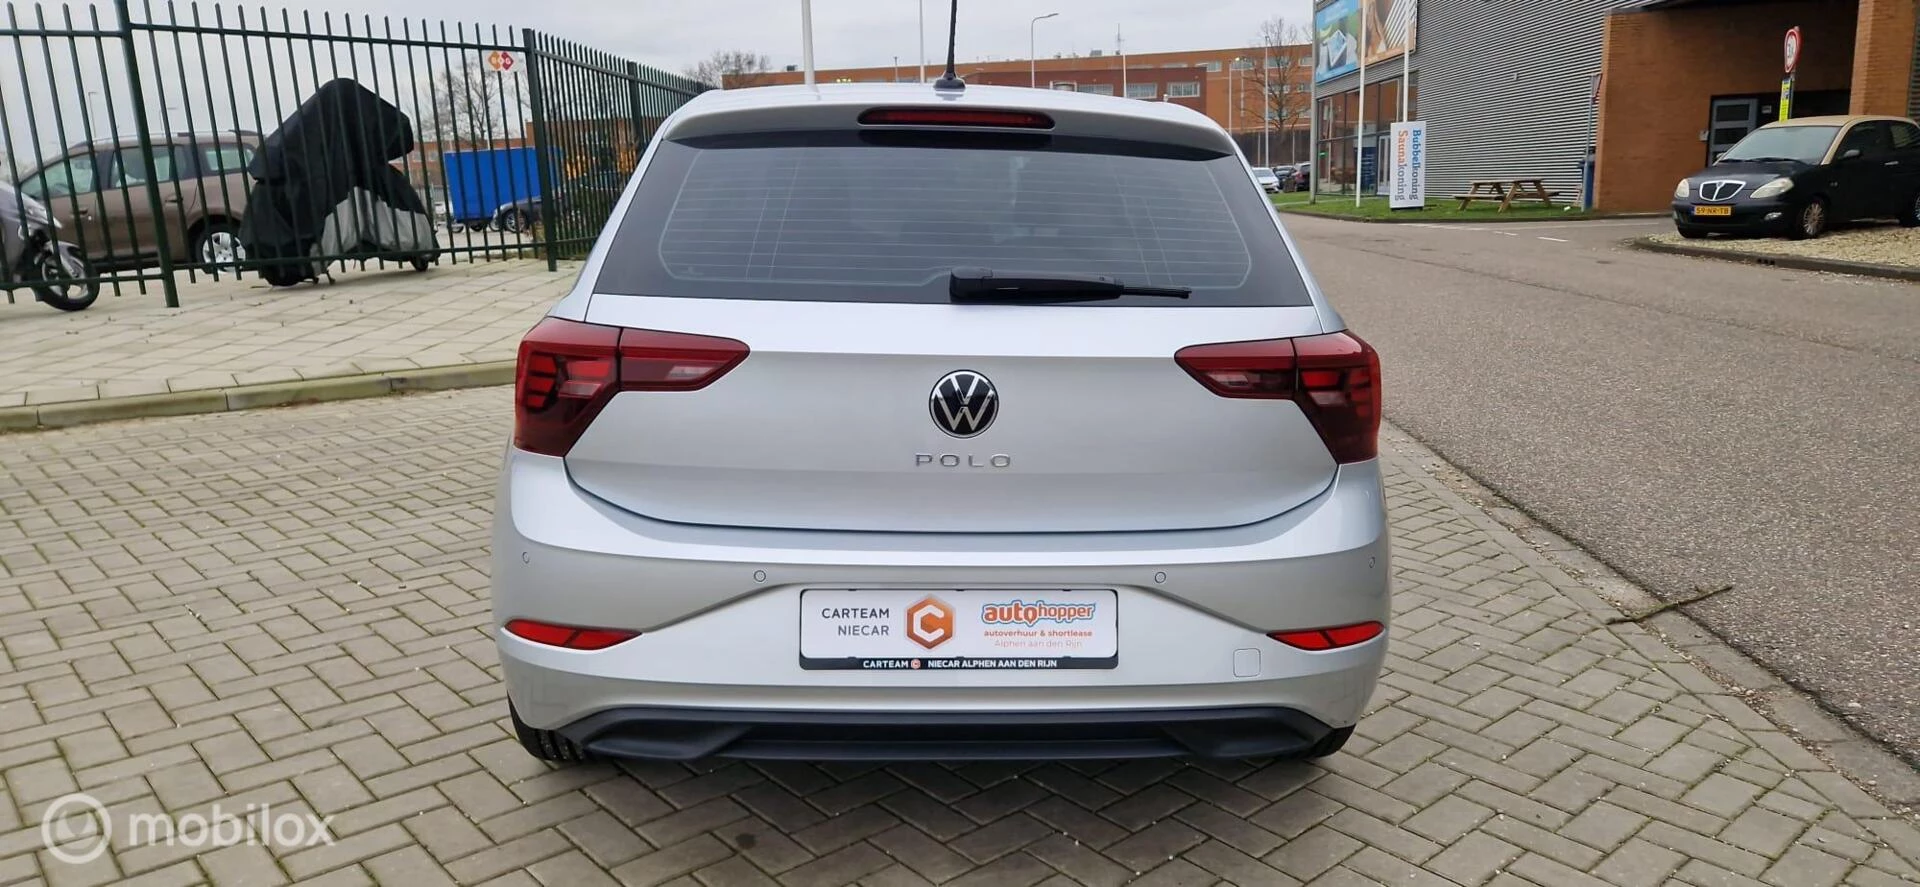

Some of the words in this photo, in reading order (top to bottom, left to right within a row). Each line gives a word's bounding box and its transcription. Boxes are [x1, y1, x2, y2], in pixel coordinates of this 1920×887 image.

[1395, 130, 1408, 201] Saunakoning
[1409, 129, 1422, 200] Bubbelkoning
[915, 453, 1011, 467] POLO
[821, 608, 890, 619] CARTEAM
[982, 600, 1096, 626] autohopper
[838, 625, 890, 636] NIECAR
[984, 629, 1037, 637] autoverhuur
[1048, 629, 1093, 637] shortlease
[994, 640, 1026, 649] Alphen
[1046, 640, 1064, 648] den
[1066, 640, 1082, 649] Rijn
[863, 660, 909, 668] CARTEAM
[927, 660, 960, 668] NIECAR
[961, 660, 997, 668] ALPHEN
[998, 660, 1017, 668] AAN
[1018, 660, 1037, 668] DEN
[1037, 660, 1057, 668] RIJN
